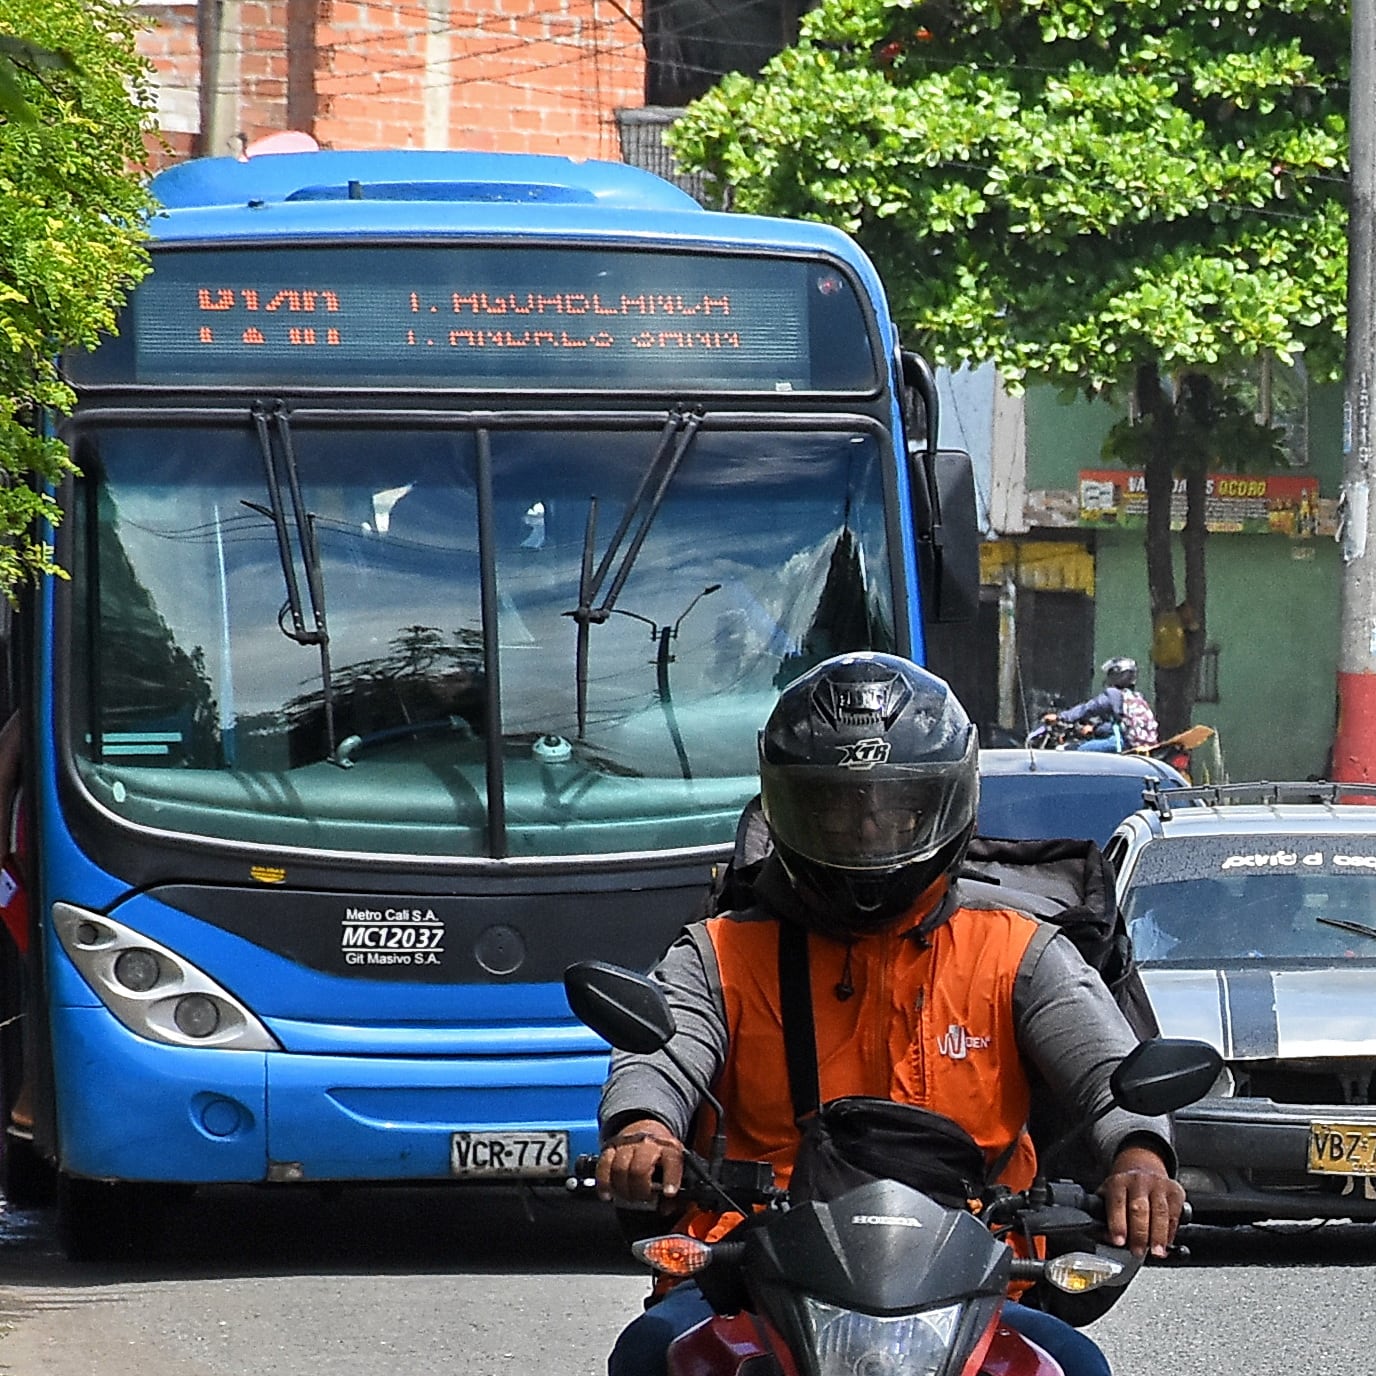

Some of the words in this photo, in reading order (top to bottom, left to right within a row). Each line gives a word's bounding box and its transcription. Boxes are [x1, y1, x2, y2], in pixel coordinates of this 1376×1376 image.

[346, 908, 382, 920] Metro
[385, 909, 410, 920] Cali
[412, 909, 439, 921] S.A.
[342, 927, 444, 948] MC12037
[345, 953, 364, 965] Git
[367, 953, 411, 965] Masivo
[414, 953, 441, 965] S.A.
